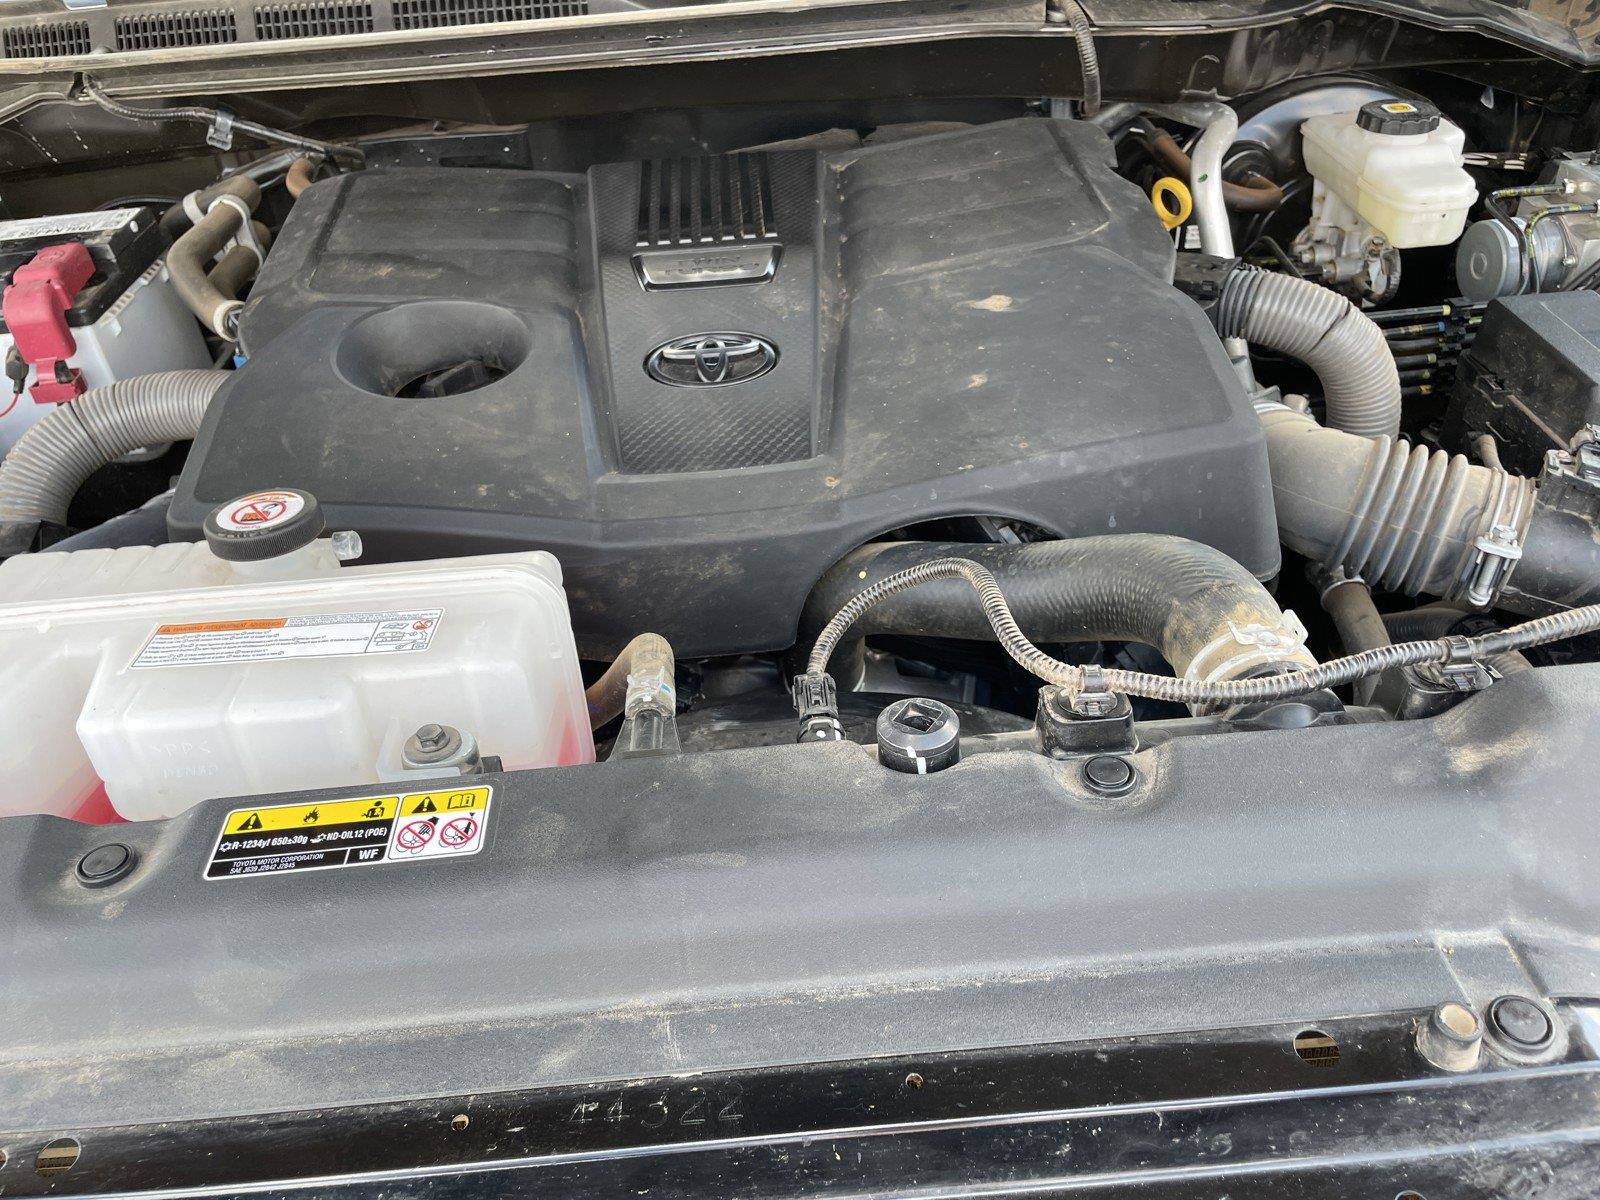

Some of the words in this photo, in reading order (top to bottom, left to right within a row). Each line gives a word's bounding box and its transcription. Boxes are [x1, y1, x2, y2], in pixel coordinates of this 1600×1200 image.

[365, 827, 387, 838] (POE)
[359, 848, 379, 860] WF
[233, 860, 257, 868] TOYOTA
[256, 856, 280, 865] MOTOR
[279, 853, 324, 864] CORPORATION
